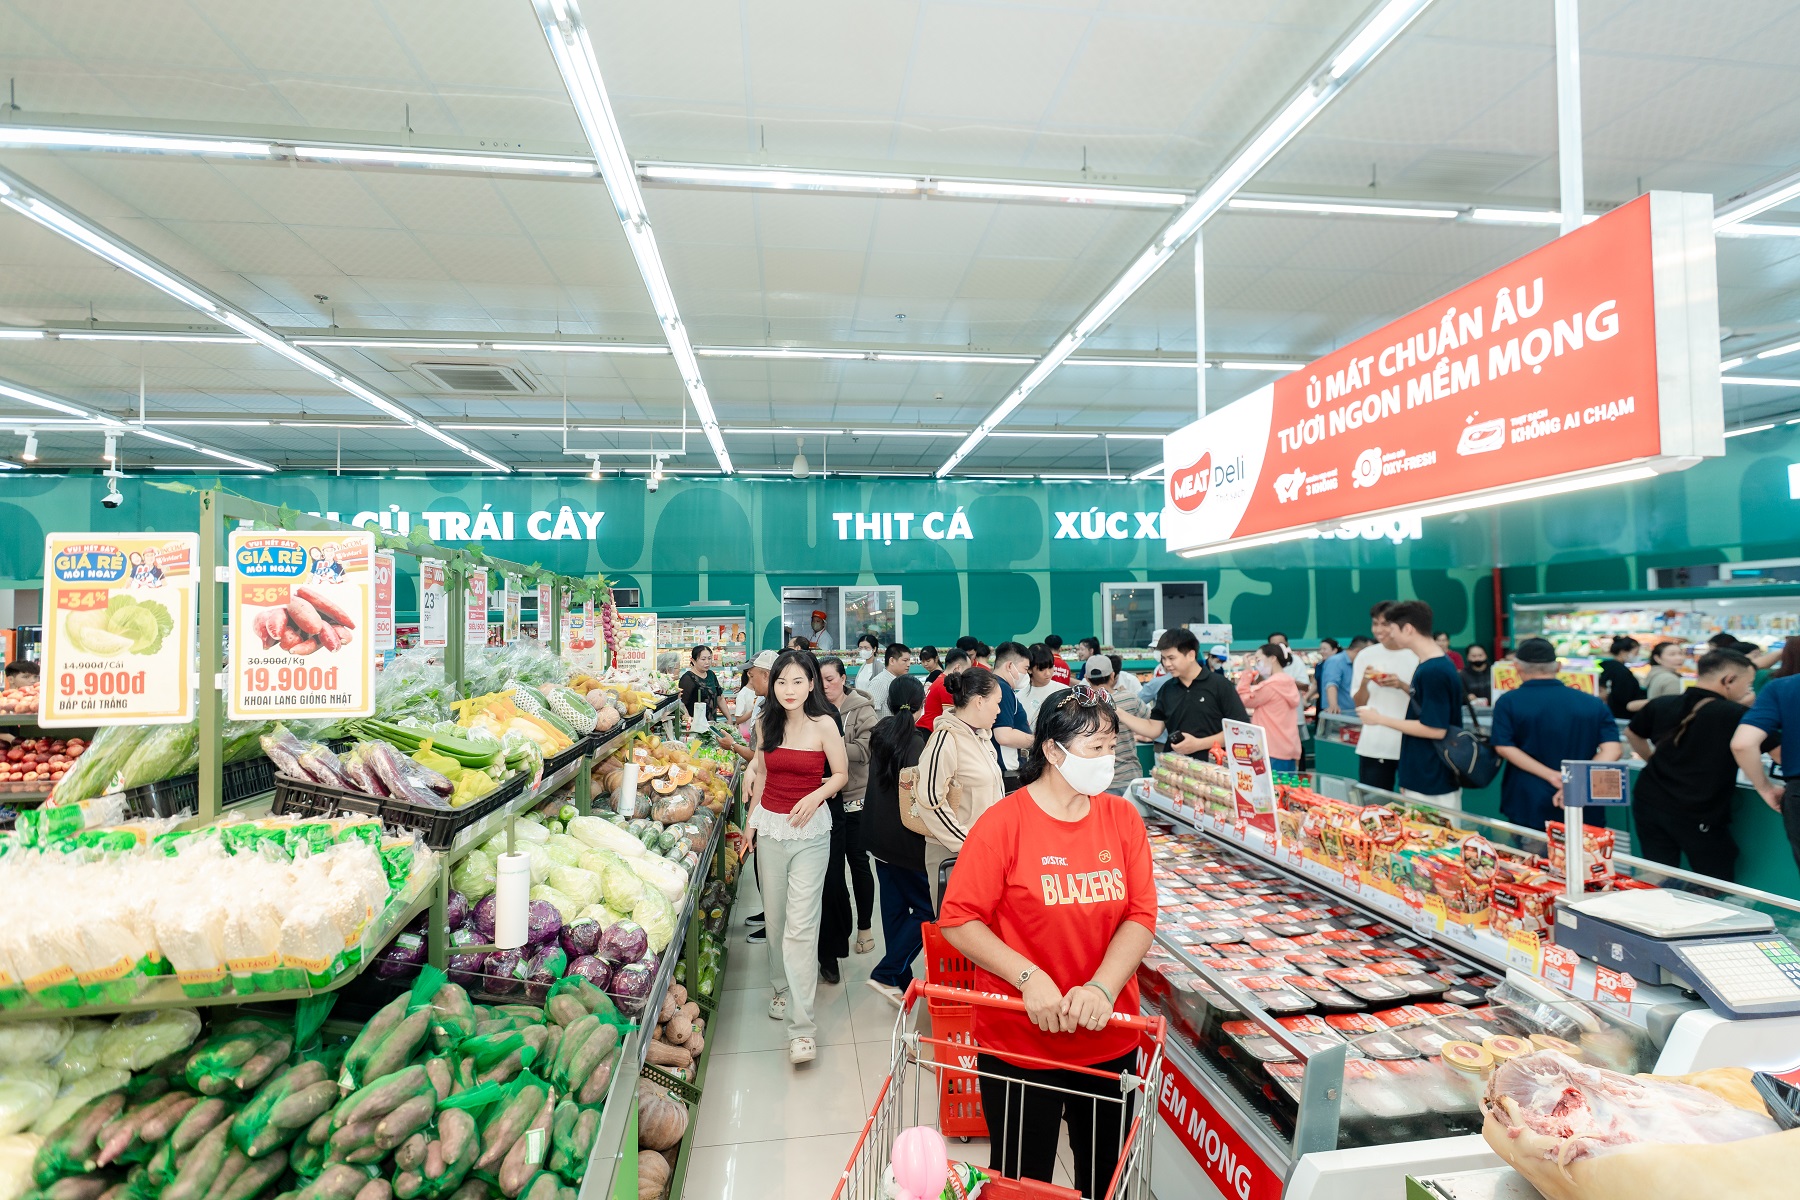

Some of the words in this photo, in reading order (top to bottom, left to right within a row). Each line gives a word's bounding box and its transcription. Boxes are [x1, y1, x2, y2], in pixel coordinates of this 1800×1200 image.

[1306, 375, 1321, 408] Ủ
[1325, 358, 1374, 401] MÁT
[1378, 307, 1483, 377] CHUẨN
[1491, 277, 1543, 332] ÂU
[1278, 413, 1325, 453] TƯƠI
[1329, 389, 1401, 436] NGON
[1406, 357, 1480, 409] MỀM
[1489, 300, 1620, 375] MỌNG
[1511, 417, 1561, 444] KHÔNG
[1563, 411, 1581, 430] AI
[1583, 396, 1635, 424] CHẠM
[1382, 450, 1437, 477] OXY-FRESH
[1174, 468, 1210, 500] MEAT
[1214, 456, 1244, 488] Deli
[1306, 484, 1312, 496] 3
[1312, 477, 1338, 494] KHÔNG
[422, 504, 514, 541] TRÁI
[526, 506, 605, 541] CÂY
[832, 512, 914, 546] THỊT
[921, 506, 974, 541] CÁ
[1053, 506, 1128, 540] XÚC
[56, 552, 92, 571] GIÁ
[98, 550, 124, 570] RẺ
[238, 547, 273, 564] GIÁ
[278, 546, 304, 564] RẺ
[60, 591, 106, 608] -34%
[244, 587, 288, 602] -36%
[424, 592, 435, 609] 23
[60, 670, 146, 696] 9.900đ
[243, 666, 338, 692] 19.900đ
[244, 696, 272, 706] KHOAI
[274, 695, 297, 705] LANG
[299, 692, 327, 704] GIỐNG
[329, 692, 352, 706] NHẬT
[1041, 868, 1126, 906] BLAZERS
[957, 1055, 978, 1069] Wi
[1187, 1107, 1253, 1200] MỌNG
